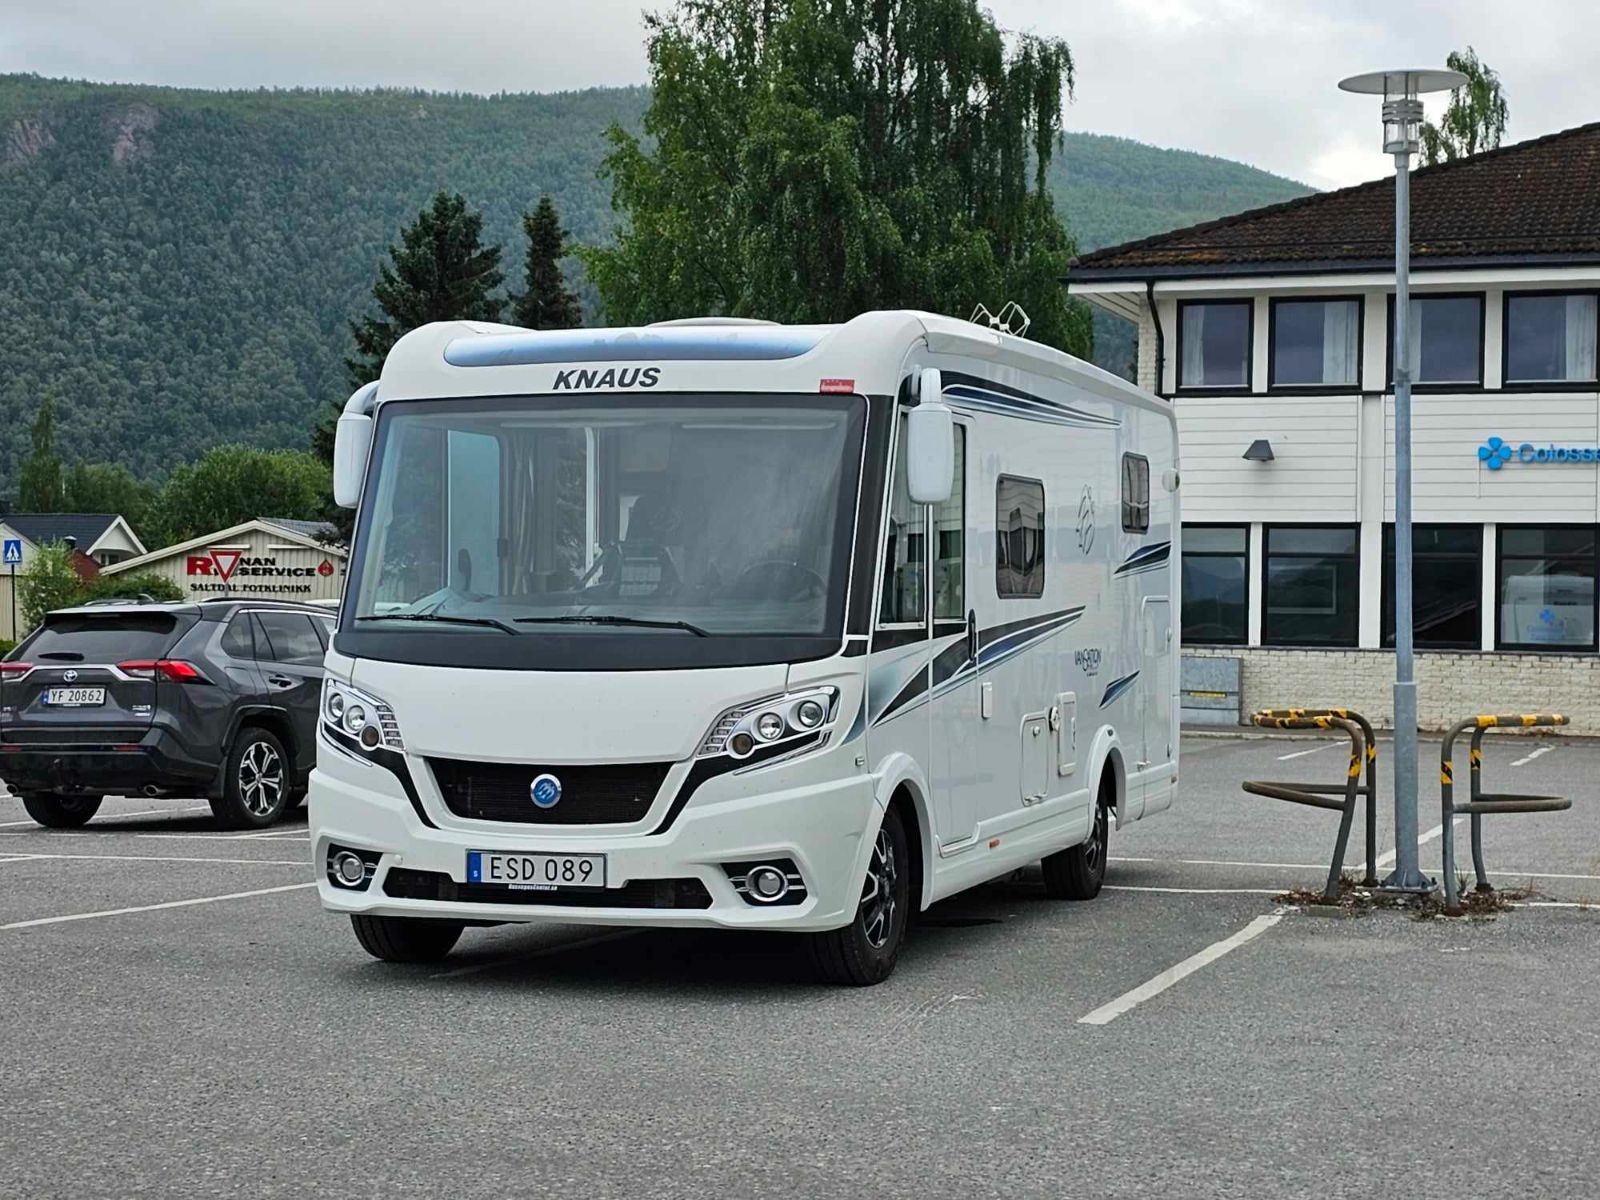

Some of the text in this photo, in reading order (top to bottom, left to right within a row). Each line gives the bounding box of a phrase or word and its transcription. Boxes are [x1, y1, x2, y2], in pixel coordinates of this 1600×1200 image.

[552, 367, 661, 390] KNAUS
[226, 567, 316, 577] SERVICE
[243, 583, 312, 593] FOTKLINIKK
[51, 690, 102, 702] YF 20862
[490, 857, 593, 882] ESD 089
